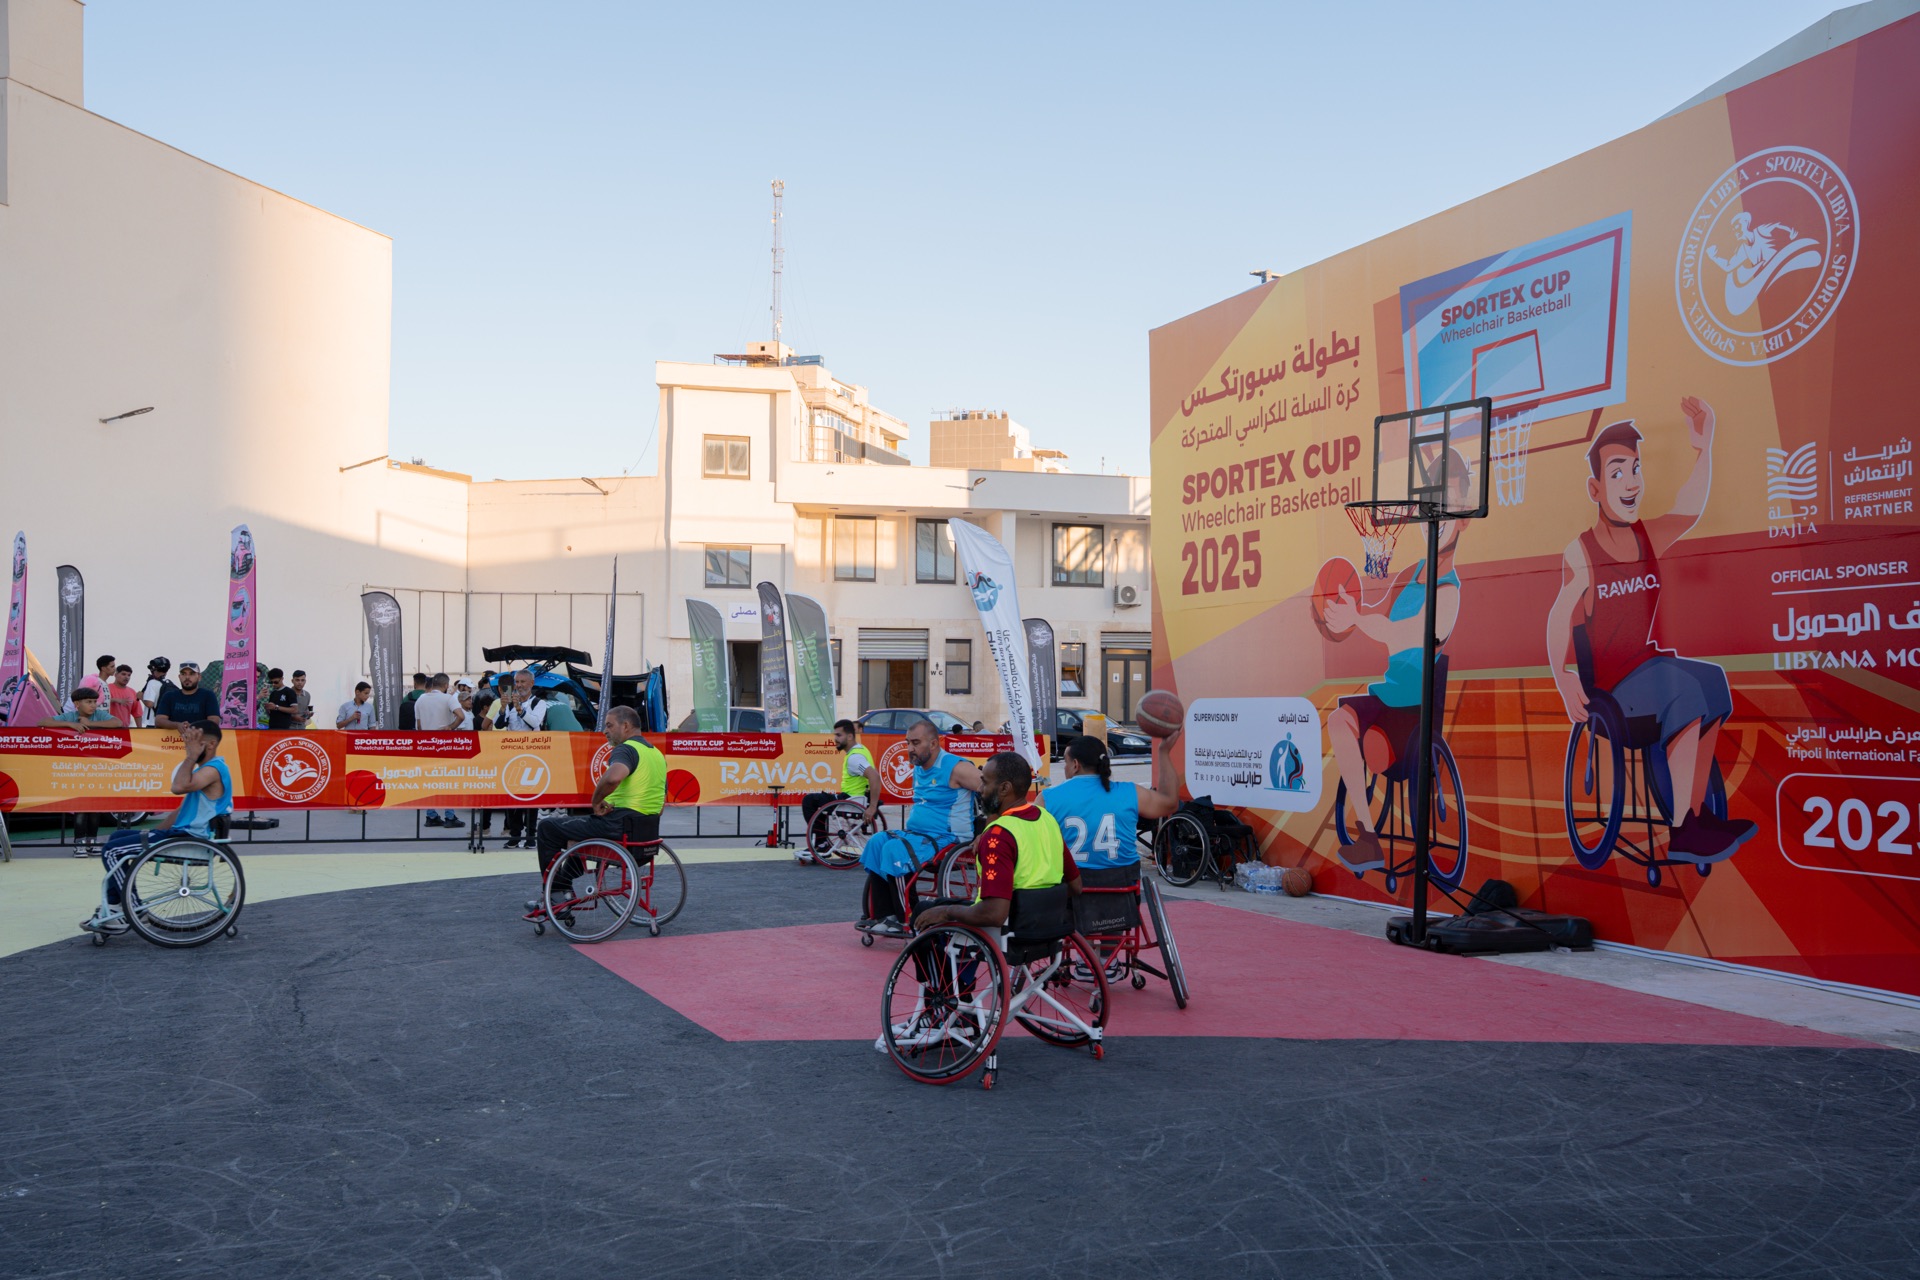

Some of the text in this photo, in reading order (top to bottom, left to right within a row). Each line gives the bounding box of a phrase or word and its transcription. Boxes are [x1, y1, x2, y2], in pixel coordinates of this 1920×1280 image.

[1765, 156, 1849, 237] SPORTEX LIBYA
[1683, 168, 1749, 289] SPORTEX LIBYA
[1441, 270, 1571, 327] SPORTEX CUP
[1750, 255, 1847, 355] SPORTEX LIBYA
[1441, 293, 1571, 345] Wheelchair Basketball
[1687, 303, 1737, 354] SPORTEX
[1181, 331, 1360, 416] بطولة سبورتكس
[1181, 379, 1360, 450] كرة السلة للكراسي المتحركة
[1843, 437, 1912, 462] شريك
[1182, 435, 1361, 505] SPORTEX CUP
[1844, 460, 1912, 486] الإنتعاش
[1845, 488, 1912, 504] REFRESHMENT
[1182, 477, 1361, 533] Wheelchair Basketball
[1769, 505, 1818, 520] دجلة
[1845, 501, 1913, 519] PARTNER
[1769, 522, 1818, 538] DAJLA
[1182, 530, 1261, 595] 2025
[1771, 561, 1908, 584] OFFICIAL SPONSER
[731, 607, 757, 619] مصلى
[1773, 602, 1881, 642] المحمول
[1773, 649, 1877, 670] LIBYANA
[1193, 713, 1239, 722] SUPERVISION BY
[1278, 713, 1310, 725] تحت إشراف
[0, 736, 53, 744] ORTEX CUP
[57, 735, 123, 745] بطولة سبورتكس
[161, 735, 185, 744] شراف
[354, 738, 413, 746] SPORTEX CUP
[417, 737, 472, 745] بطولة سبورتكس
[501, 736, 551, 744] الراعي الرسمي
[727, 738, 776, 746] بطولة سبورتكس
[1785, 726, 1920, 745] عرض طرابلس الدولي
[1226, 749, 1247, 760] التضامن
[1248, 750, 1262, 761] نادي
[1786, 746, 1822, 761] Tripoli
[1825, 747, 1904, 762] International
[376, 766, 497, 779] ليبيانا للهاتف المحمول
[1194, 772, 1230, 783] TRIPOLI
[1230, 770, 1262, 788] طرابلس
[51, 781, 110, 789] TRIPOLI
[113, 779, 162, 792] طرابلس
[375, 782, 497, 790] LIBYANA MOBILE PHONE
[1802, 796, 1920, 856] 202
[1065, 813, 1120, 862] 24
[1092, 916, 1126, 927] Multisport
